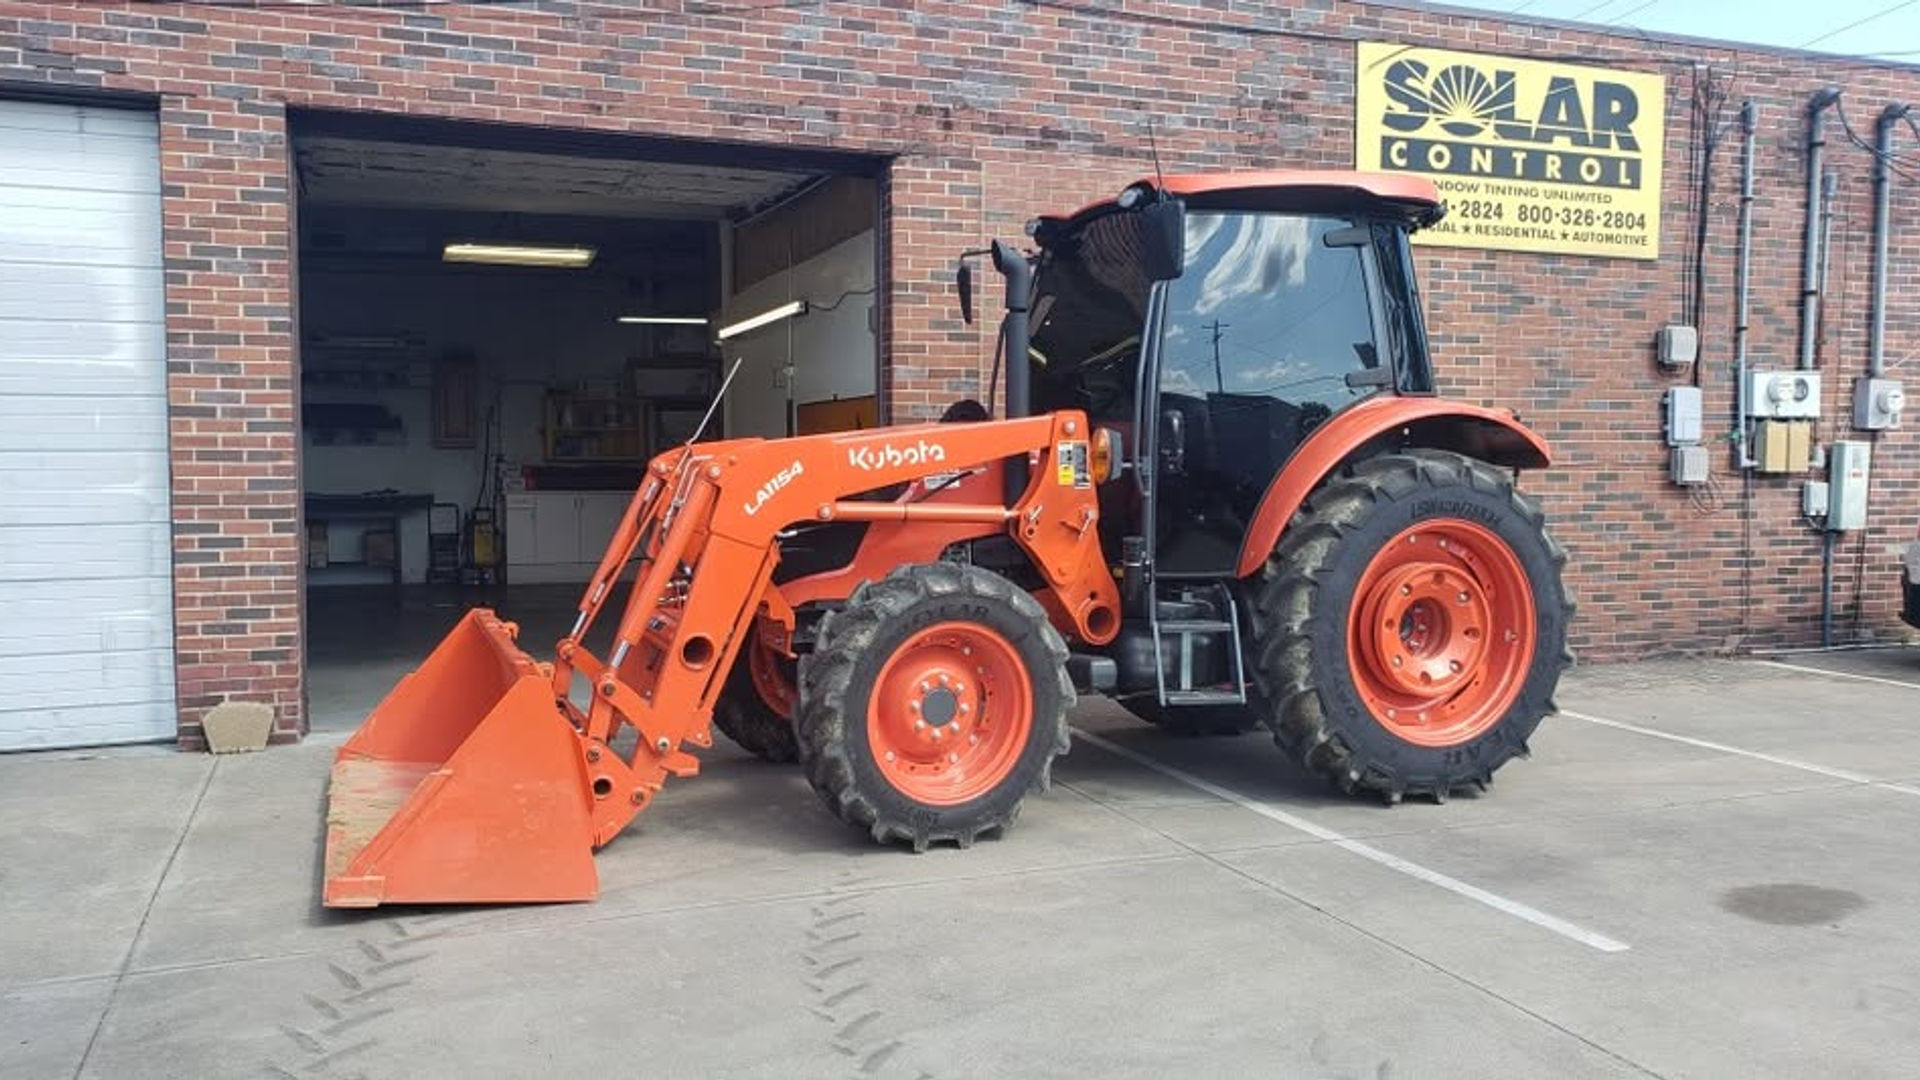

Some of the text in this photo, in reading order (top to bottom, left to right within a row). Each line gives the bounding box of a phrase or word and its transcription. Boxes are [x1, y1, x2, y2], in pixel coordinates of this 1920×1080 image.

[1381, 58, 1641, 151] SOLAR
[1389, 140, 1632, 185] CONTROL
[1484, 183, 1539, 198] TINTING
[1543, 190, 1612, 204] UNLIMITED
[1475, 225, 1648, 246] RESIDENTIAL AUTOMOTIVE
[848, 439, 946, 471] Kubota
[743, 459, 804, 516] LA1154
